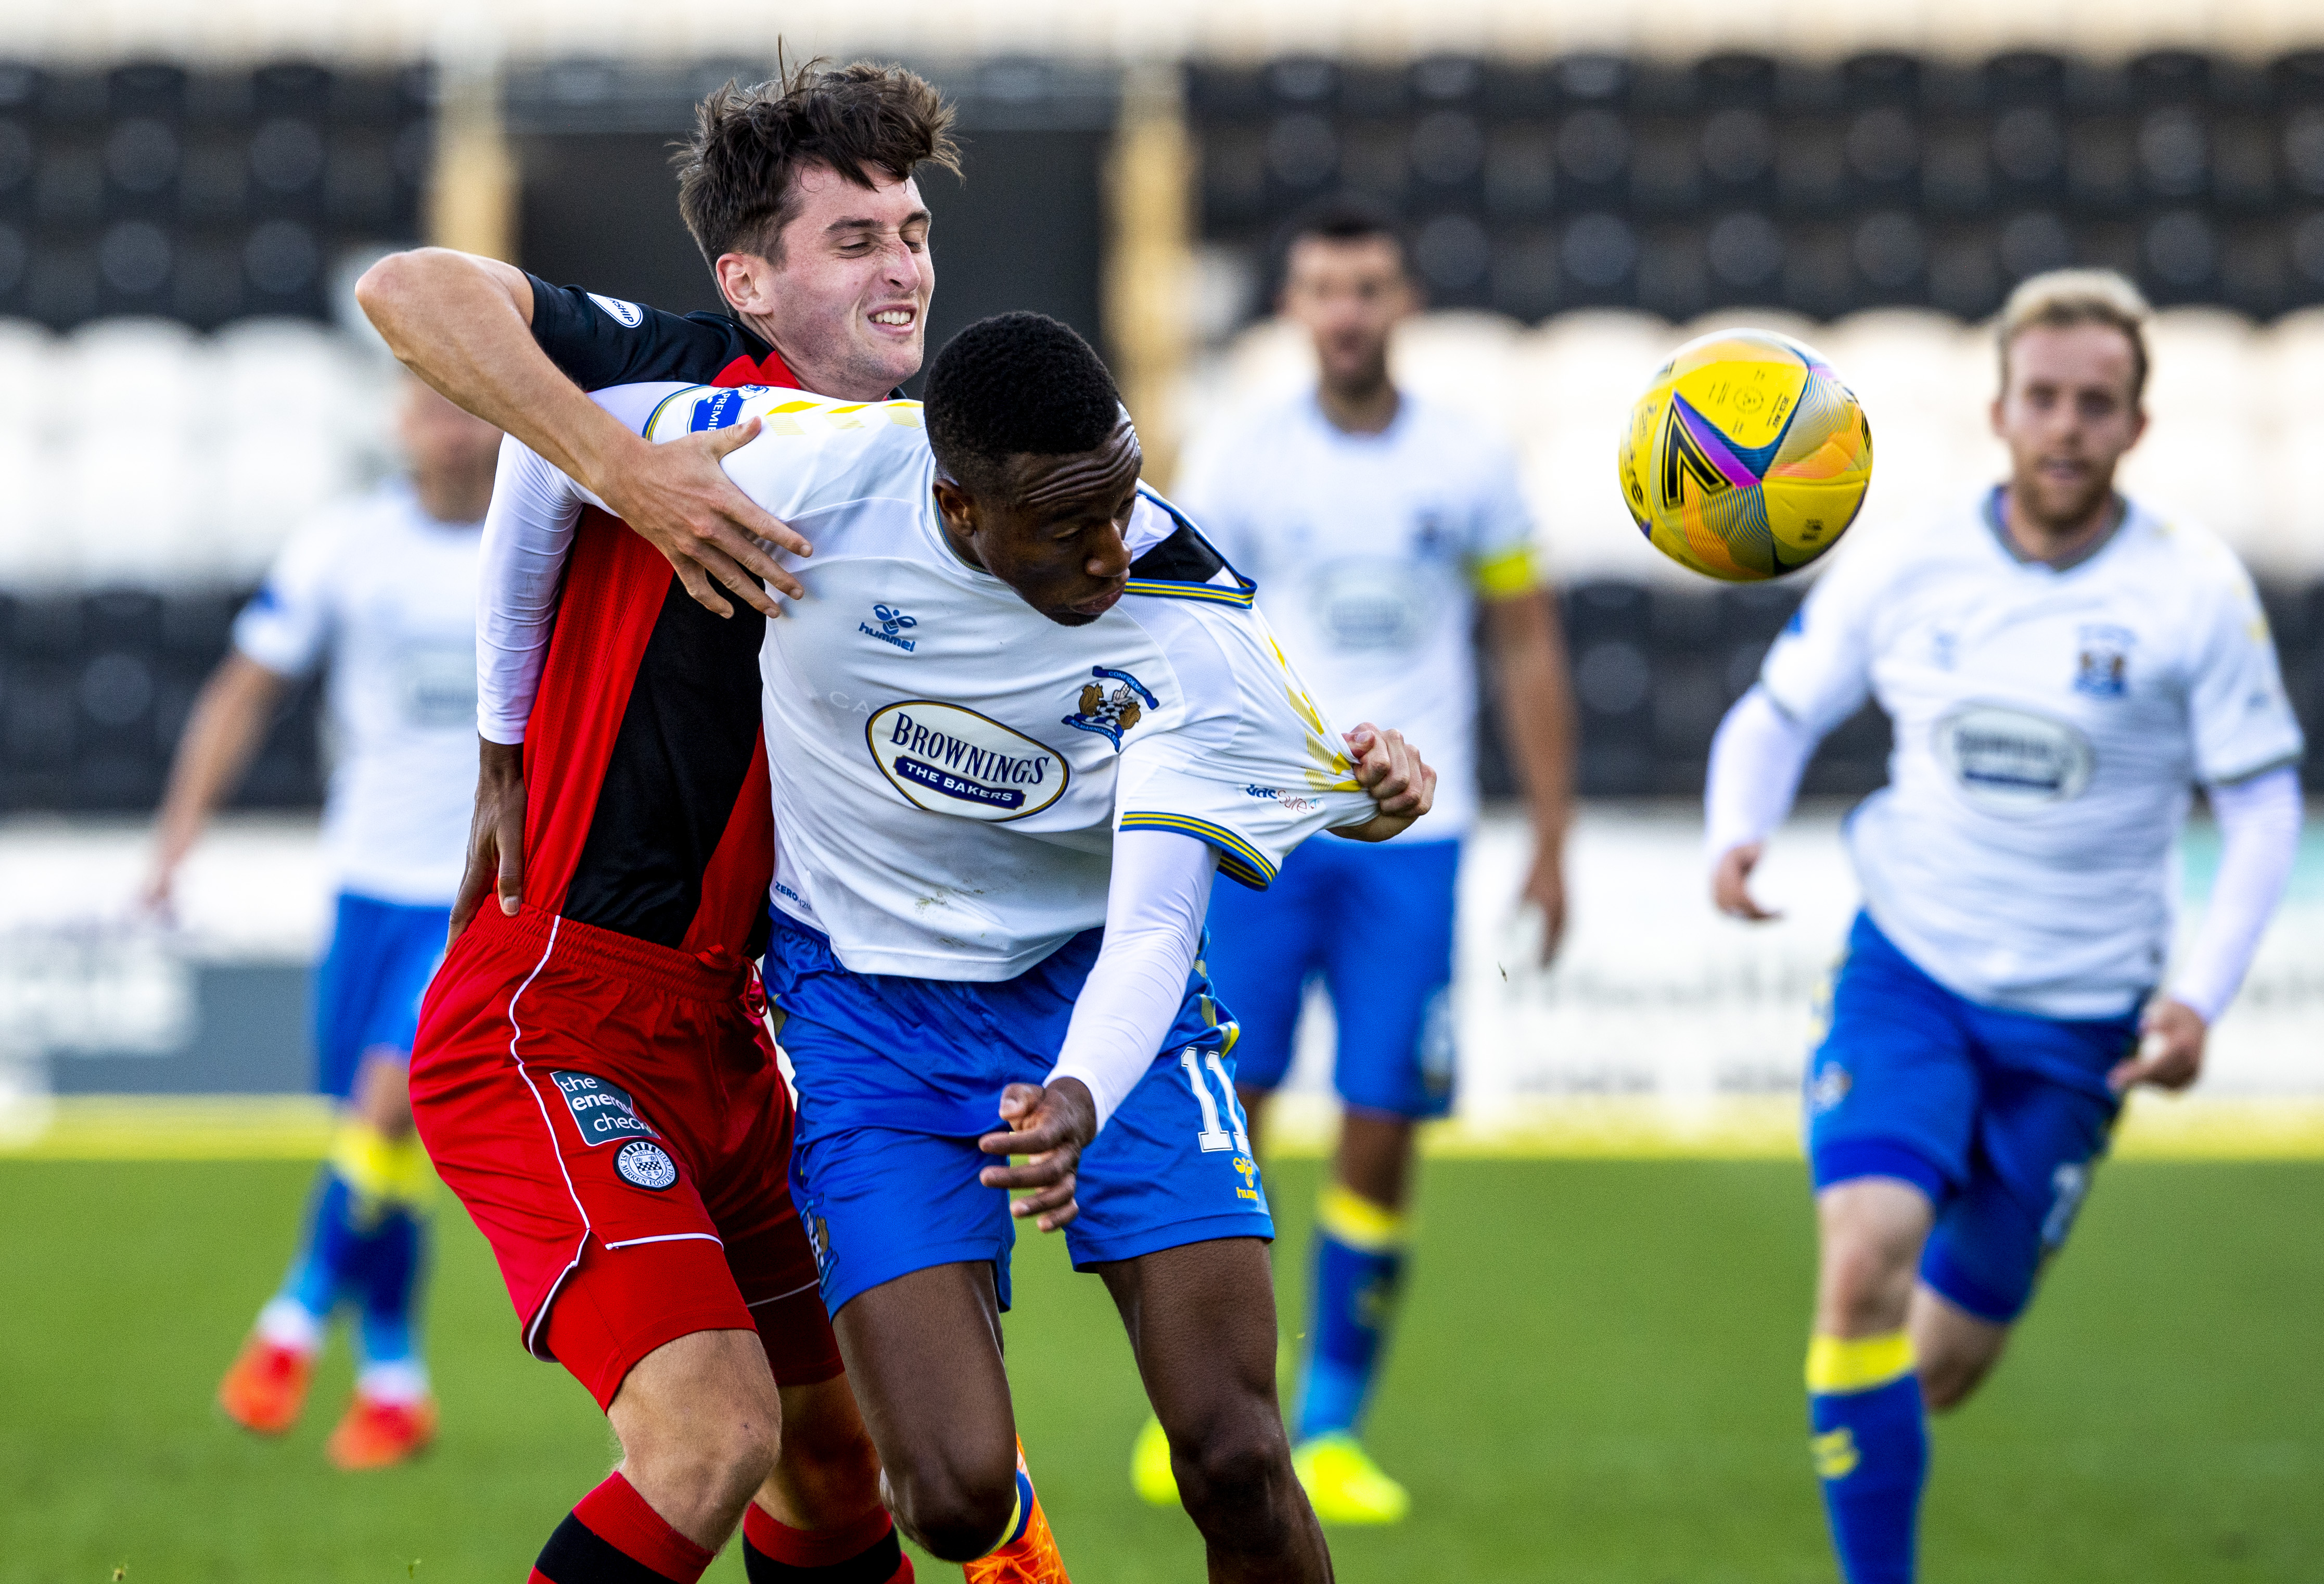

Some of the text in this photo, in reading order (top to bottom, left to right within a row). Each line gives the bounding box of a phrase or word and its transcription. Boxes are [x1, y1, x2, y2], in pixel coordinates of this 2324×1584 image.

[859, 622, 915, 652] hummel
[890, 712, 1050, 785] BROWNINGS
[906, 763, 1013, 803] THE BAKERS
[560, 1076, 597, 1092] the
[1181, 1046, 1250, 1156] 11
[622, 1165, 647, 1184] MIRREN
[649, 1169, 674, 1186] FOOTBALL
